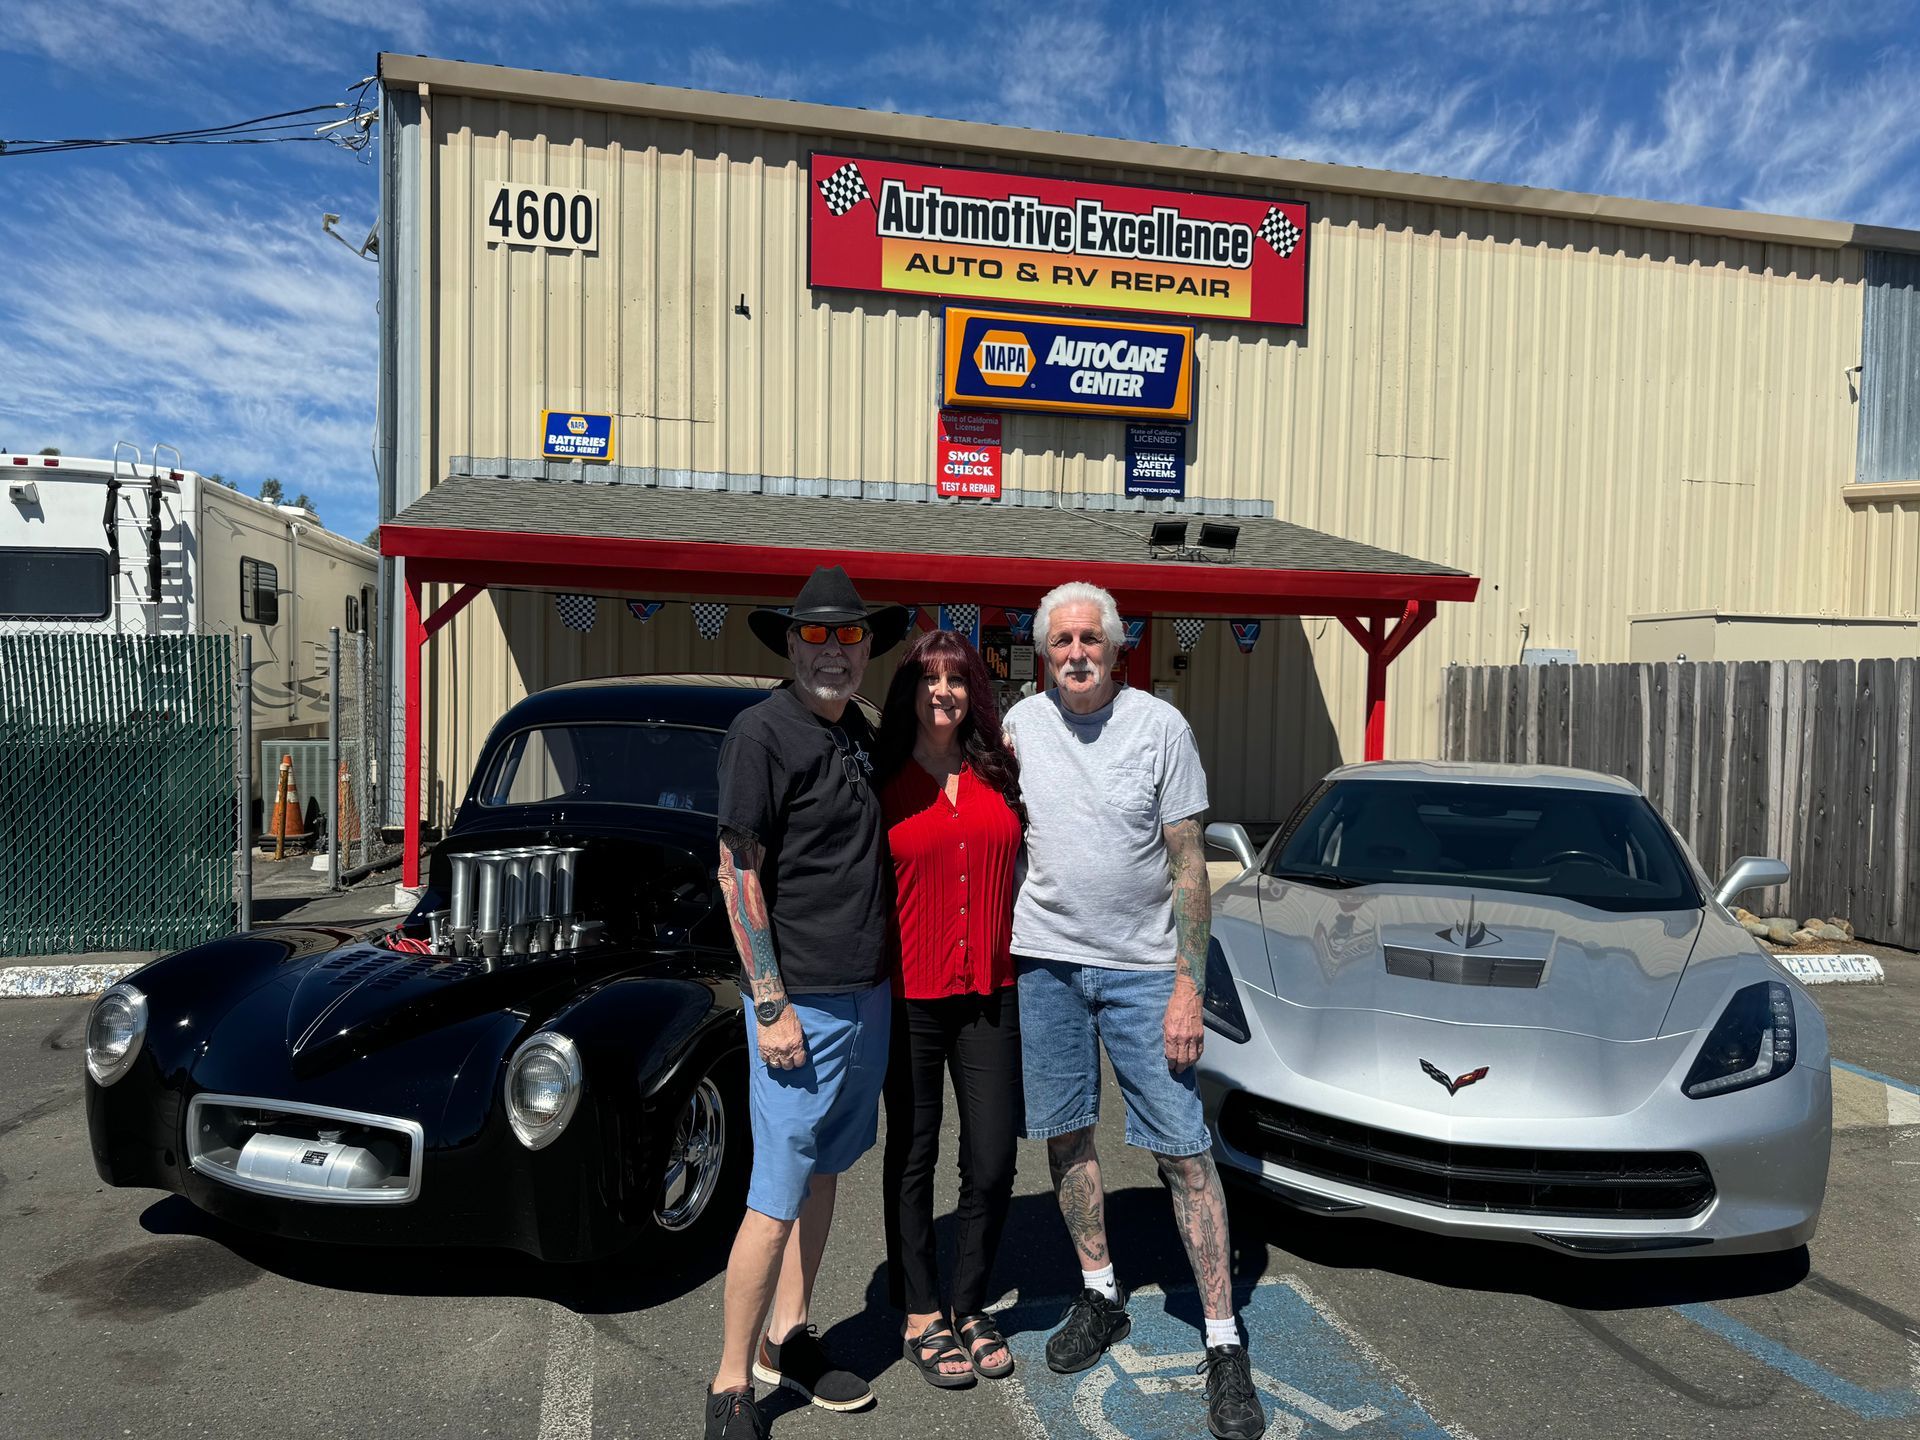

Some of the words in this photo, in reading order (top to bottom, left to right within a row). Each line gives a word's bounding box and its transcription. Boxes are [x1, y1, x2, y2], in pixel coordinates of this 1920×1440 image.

[489, 188, 593, 245] 4600
[882, 184, 1073, 249] Automotive
[1080, 204, 1250, 265] Excellence
[905, 253, 1003, 280] AUTO
[1016, 262, 1040, 283] &
[1052, 266, 1099, 287] RV
[1111, 270, 1230, 298] REPAIR
[984, 344, 1027, 373] NAPA
[1069, 369, 1145, 398] CENTER
[570, 420, 586, 430] NAPA
[942, 414, 958, 422] State
[960, 415, 966, 423] of
[967, 417, 999, 425] California
[955, 423, 984, 431] Licensed
[548, 434, 607, 448] BATTERIES
[973, 437, 1000, 445] Certified
[1134, 435, 1177, 444] LICENSED
[554, 445, 576, 454] SOLD
[577, 446, 600, 455] HERE!
[948, 451, 990, 462] SMOG
[1135, 452, 1176, 462] VEHICLE
[944, 464, 994, 476] CHECK
[1136, 461, 1173, 469] SAFETY
[1132, 469, 1176, 478] SYSTEMS
[941, 482, 960, 492] TEST
[962, 483, 967, 492] &
[969, 483, 996, 494] REPAIR
[1786, 956, 1872, 974] CELLENCE
